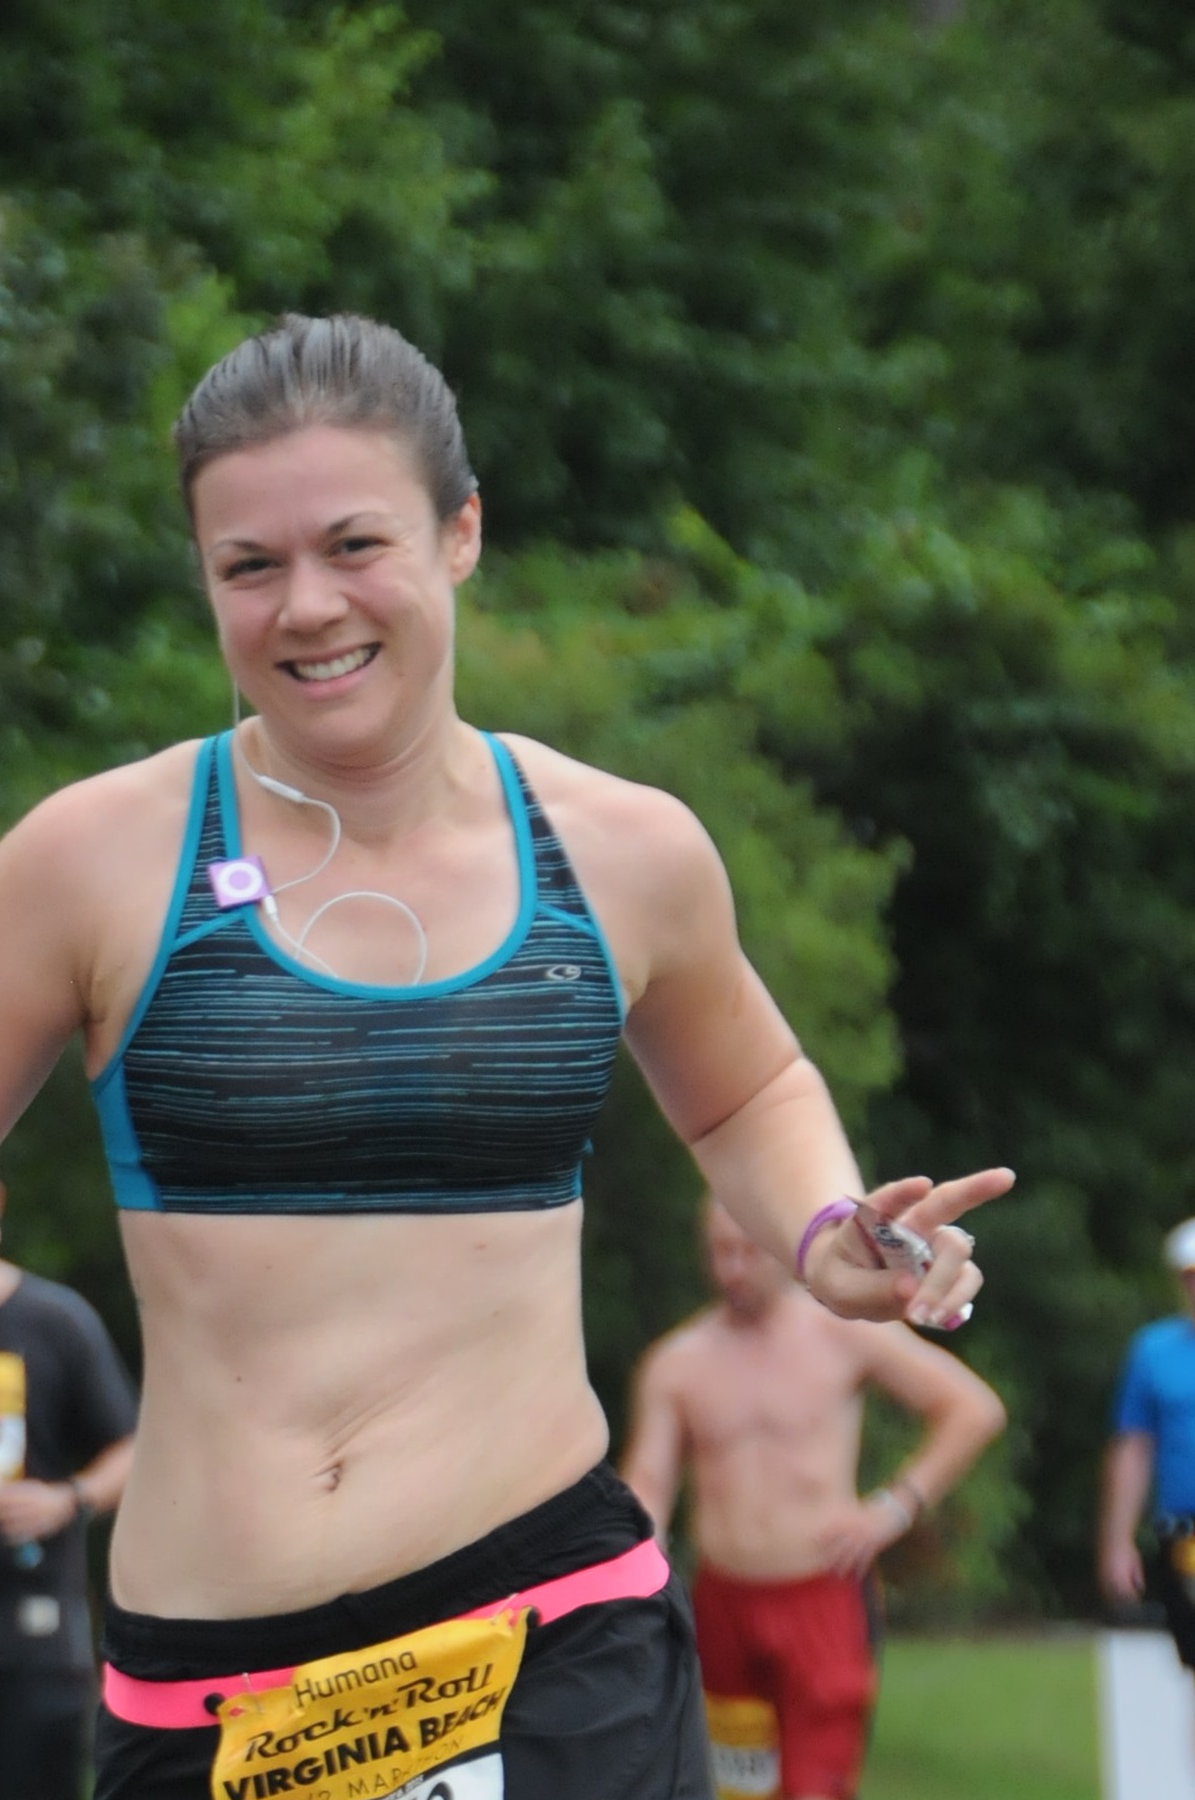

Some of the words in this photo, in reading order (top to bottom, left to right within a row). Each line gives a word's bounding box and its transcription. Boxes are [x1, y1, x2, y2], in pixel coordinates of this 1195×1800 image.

[294, 1650, 419, 1709] Humana
[244, 1708, 362, 1763] Rock
[419, 1685, 508, 1749] BEACH
